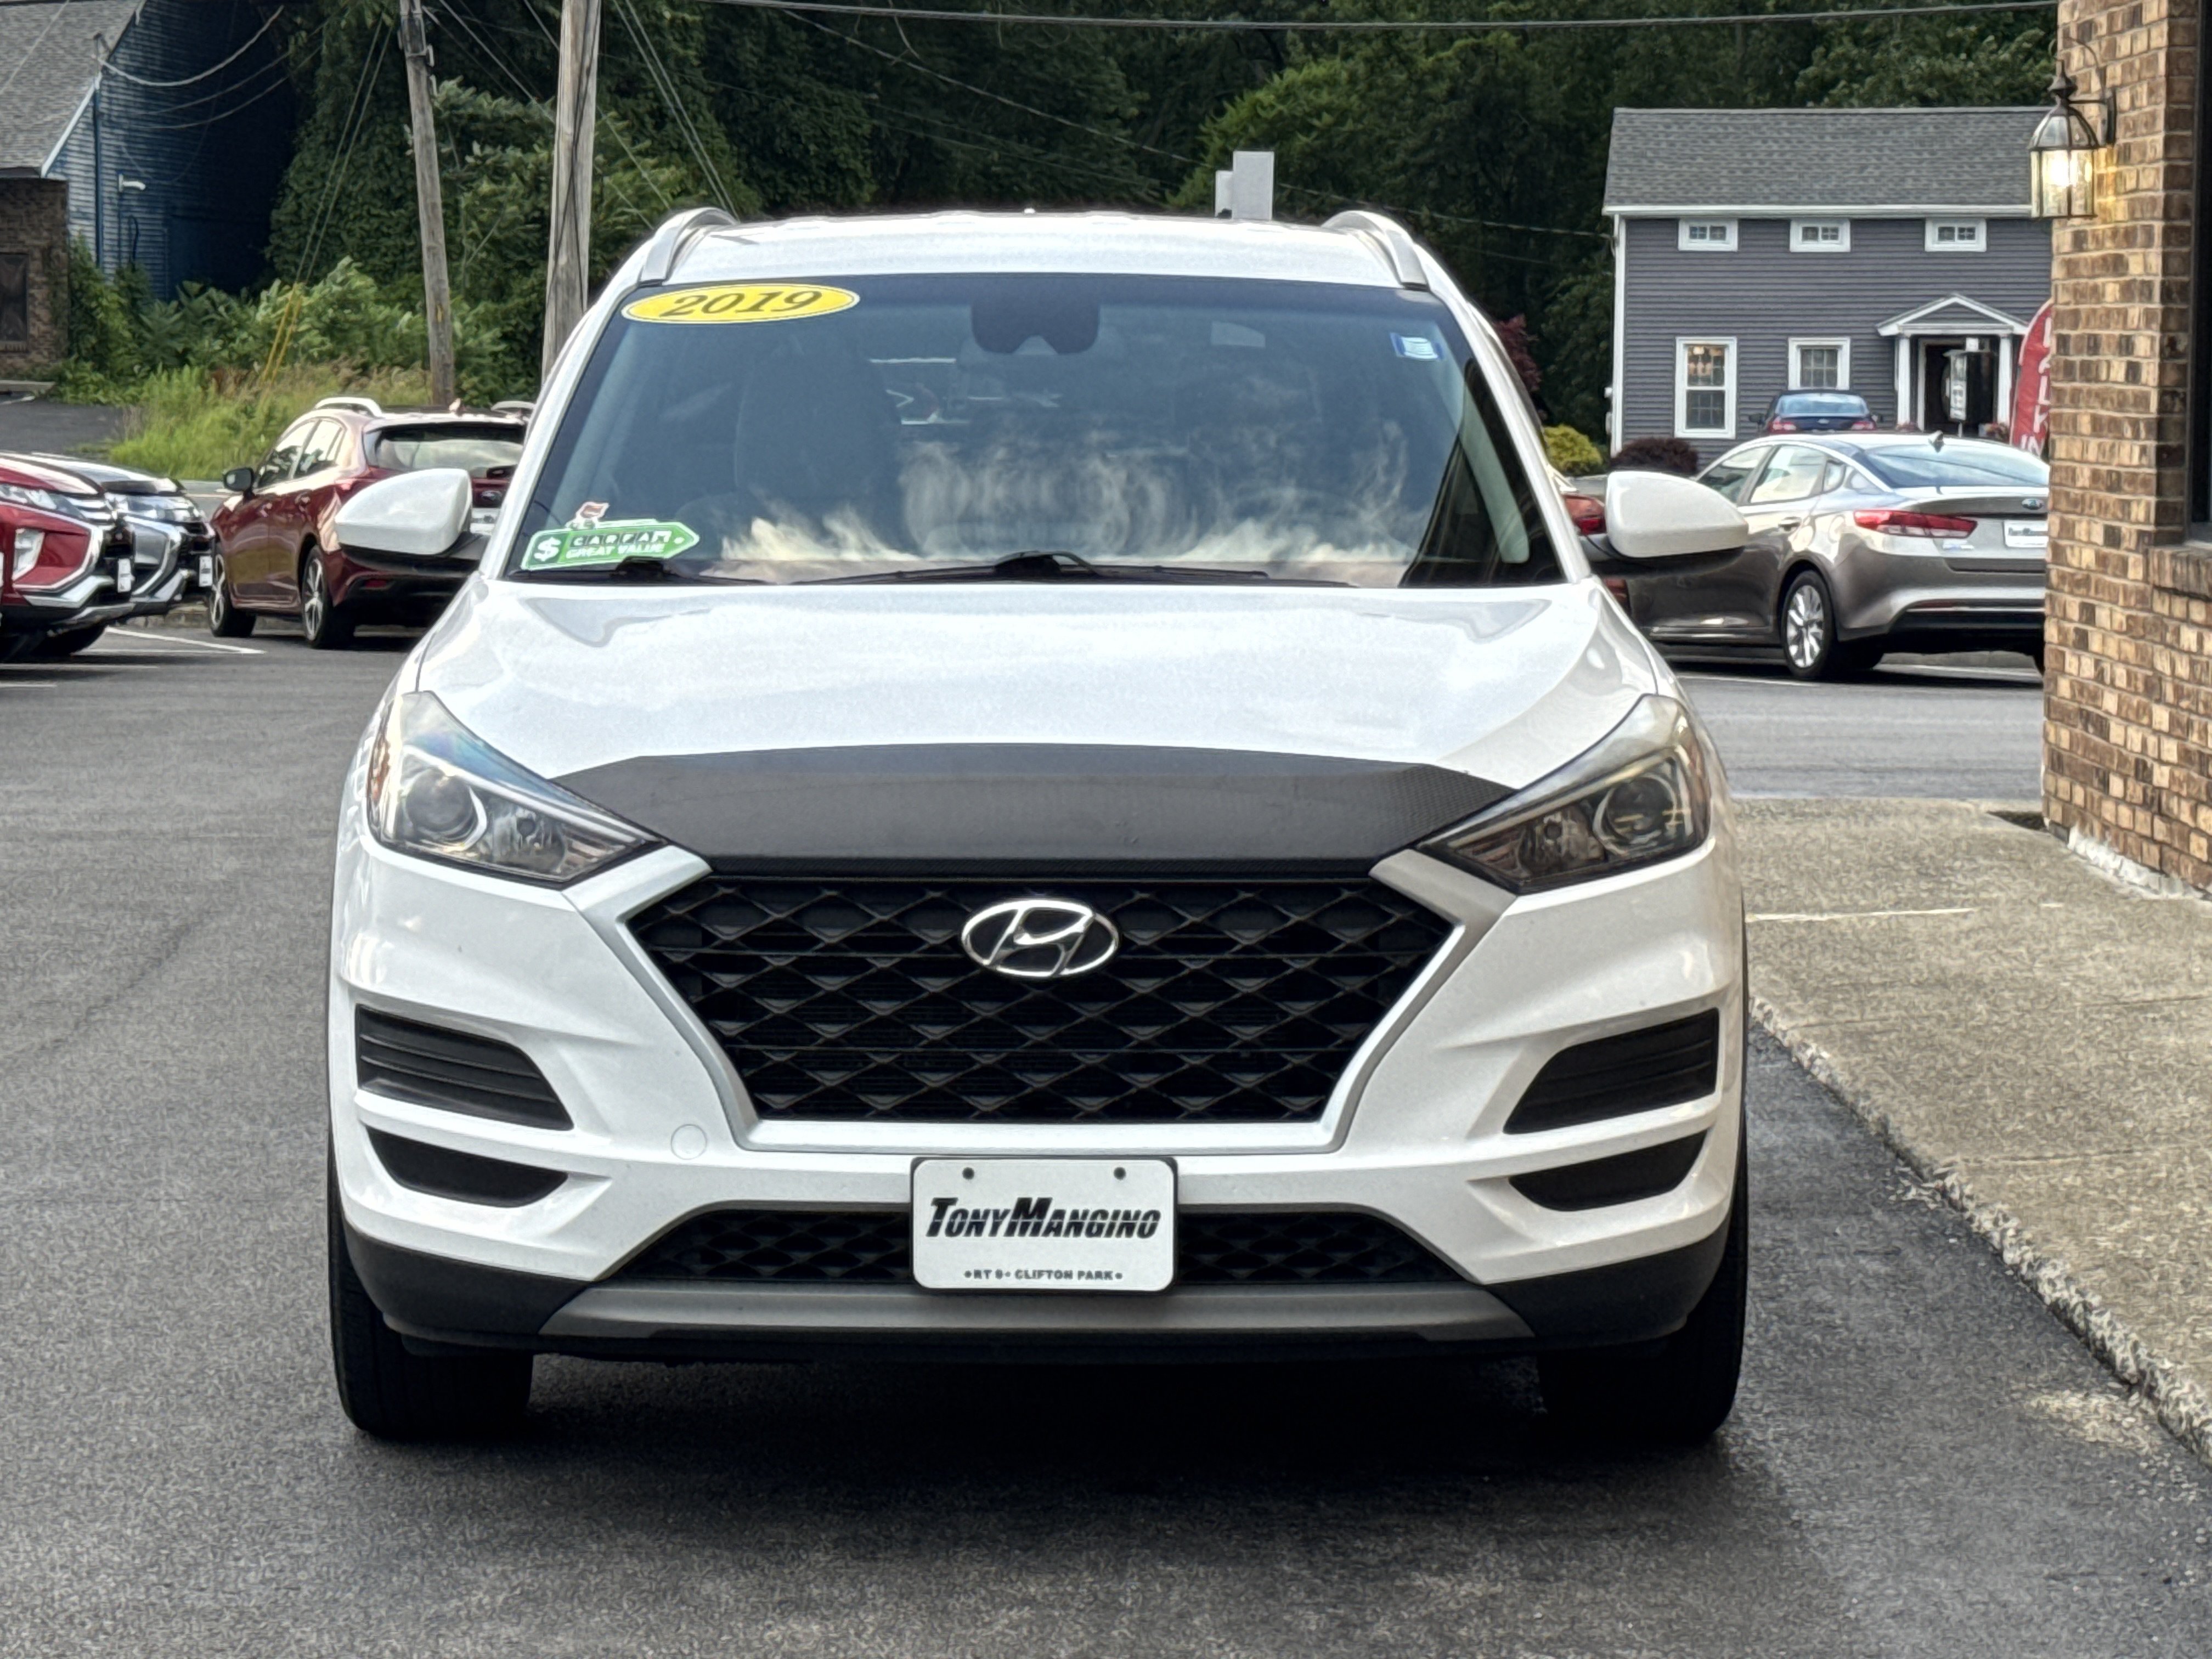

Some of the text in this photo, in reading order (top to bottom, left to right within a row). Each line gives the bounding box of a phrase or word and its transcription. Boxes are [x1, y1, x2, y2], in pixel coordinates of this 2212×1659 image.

[659, 290, 823, 318] 2019
[973, 1269, 992, 1279] RT
[1015, 1268, 1073, 1280] CLIFTON
[1077, 1269, 1114, 1280] PARK
